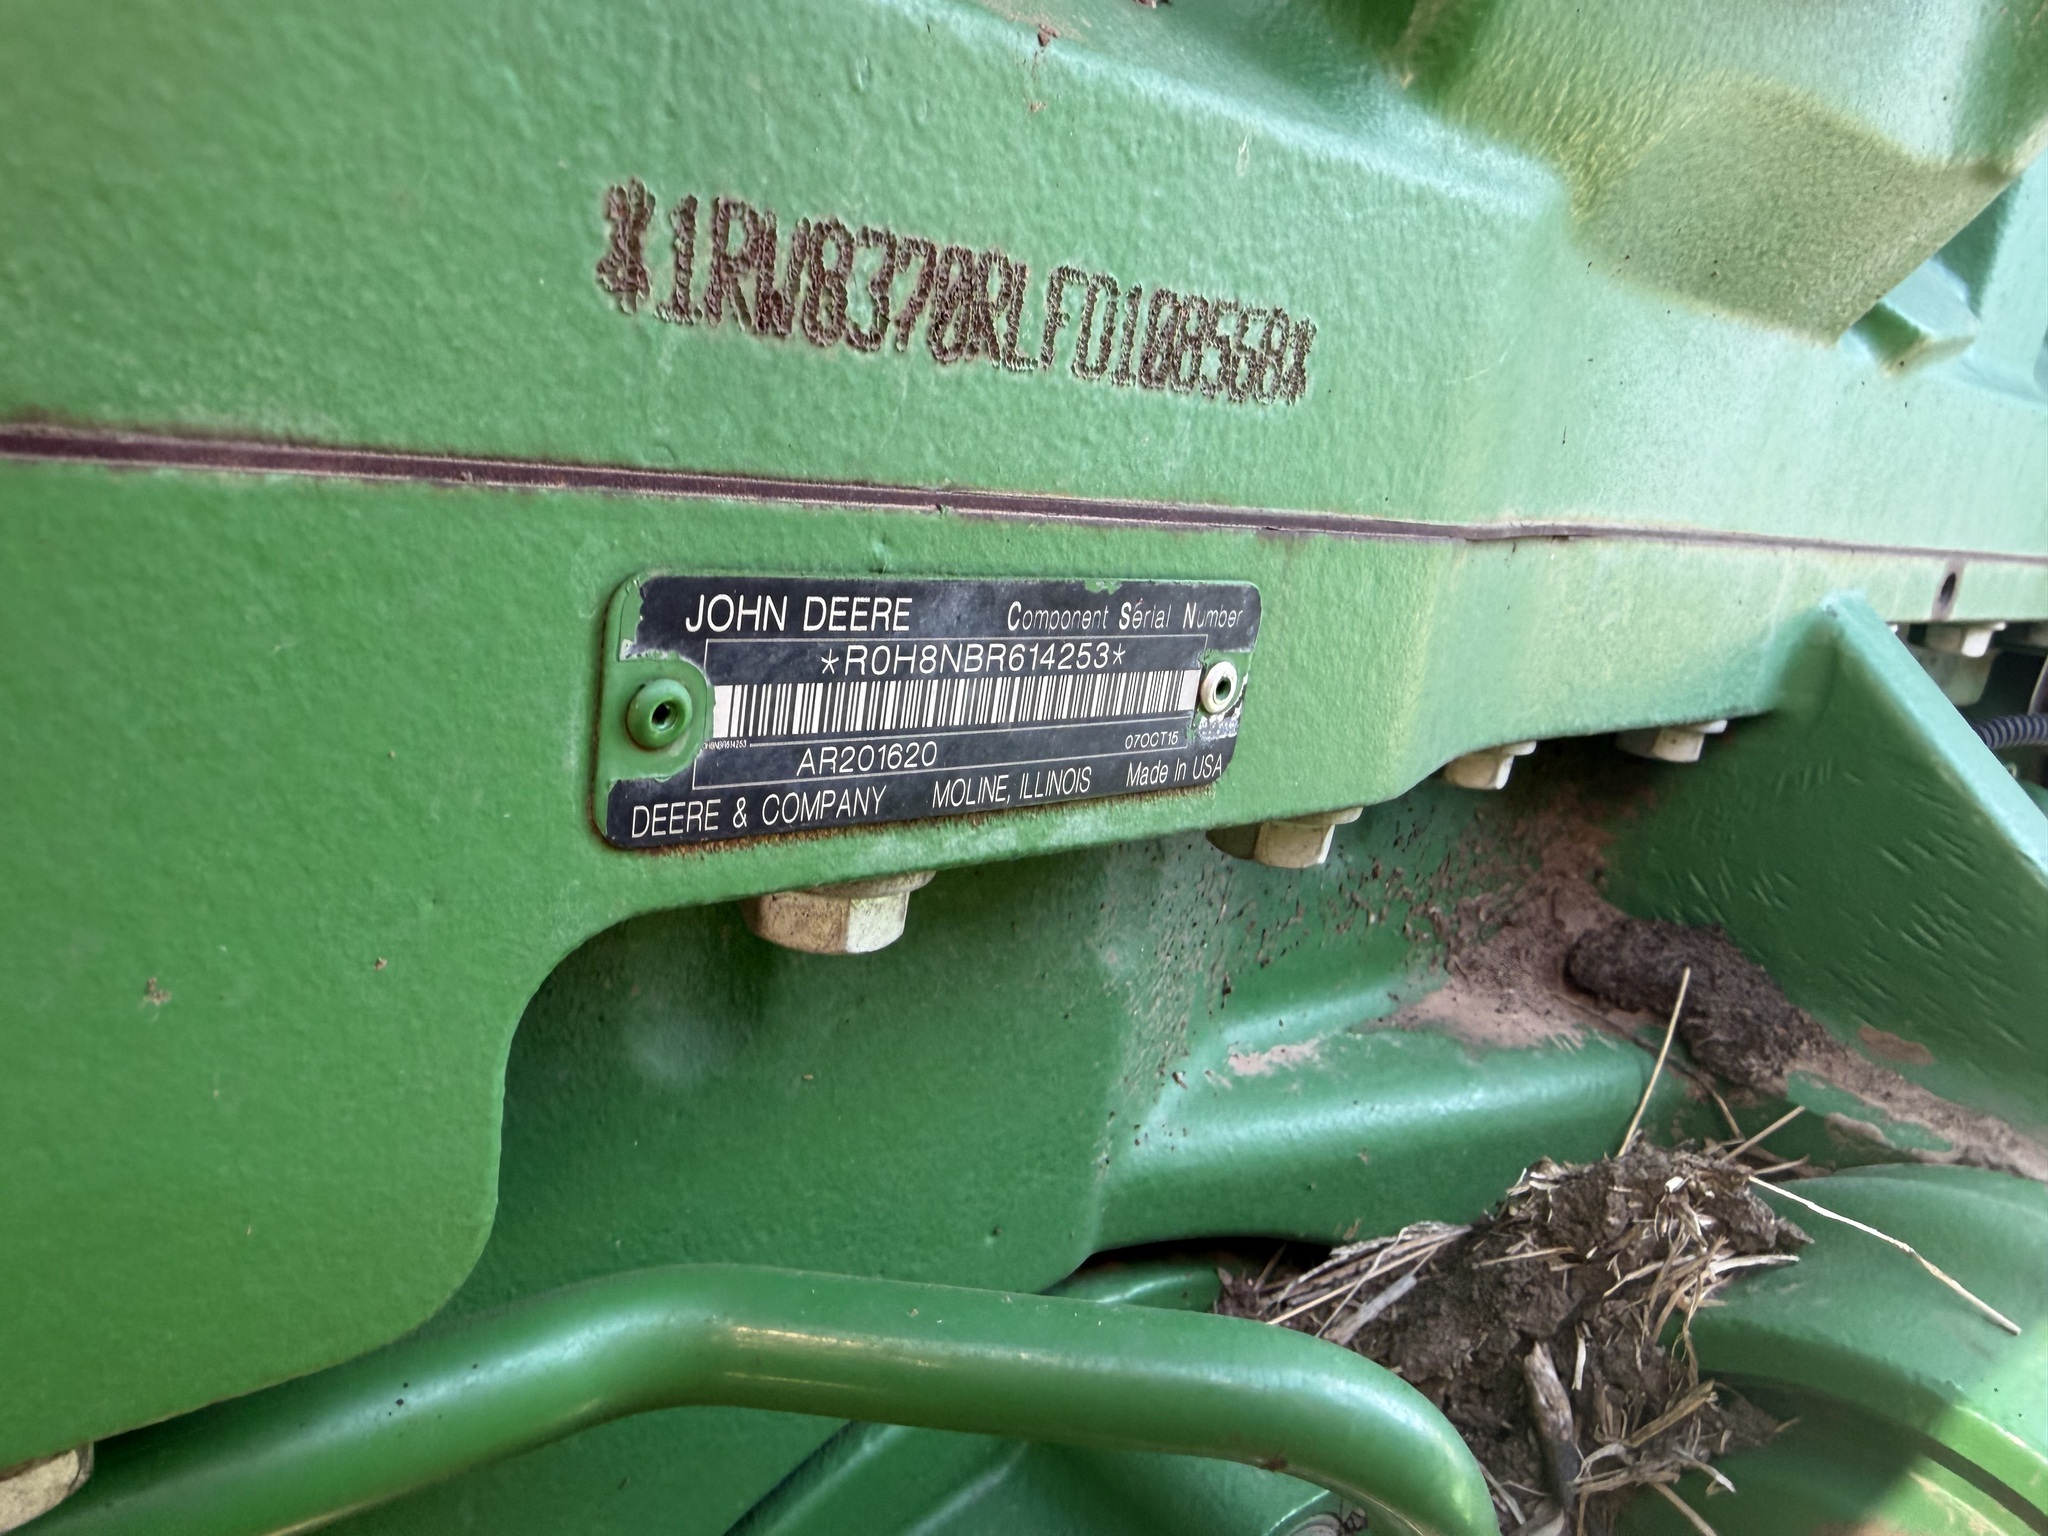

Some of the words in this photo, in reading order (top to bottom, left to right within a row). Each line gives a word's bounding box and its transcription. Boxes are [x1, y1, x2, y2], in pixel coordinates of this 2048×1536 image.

[685, 593, 788, 632] JOHN
[803, 597, 913, 631] DEERE
[1007, 600, 1109, 634] Component
[1118, 601, 1172, 630] Serial
[1182, 601, 1243, 629] Number
[796, 741, 938, 776] AR201620
[1125, 759, 1169, 788] Made
[1192, 753, 1222, 780] USA
[932, 774, 1010, 809] MOLINE,
[1019, 766, 1092, 799] ILLINOIS
[631, 799, 721, 838] DEERE
[732, 796, 748, 828] &
[761, 785, 887, 826] COMPANY
